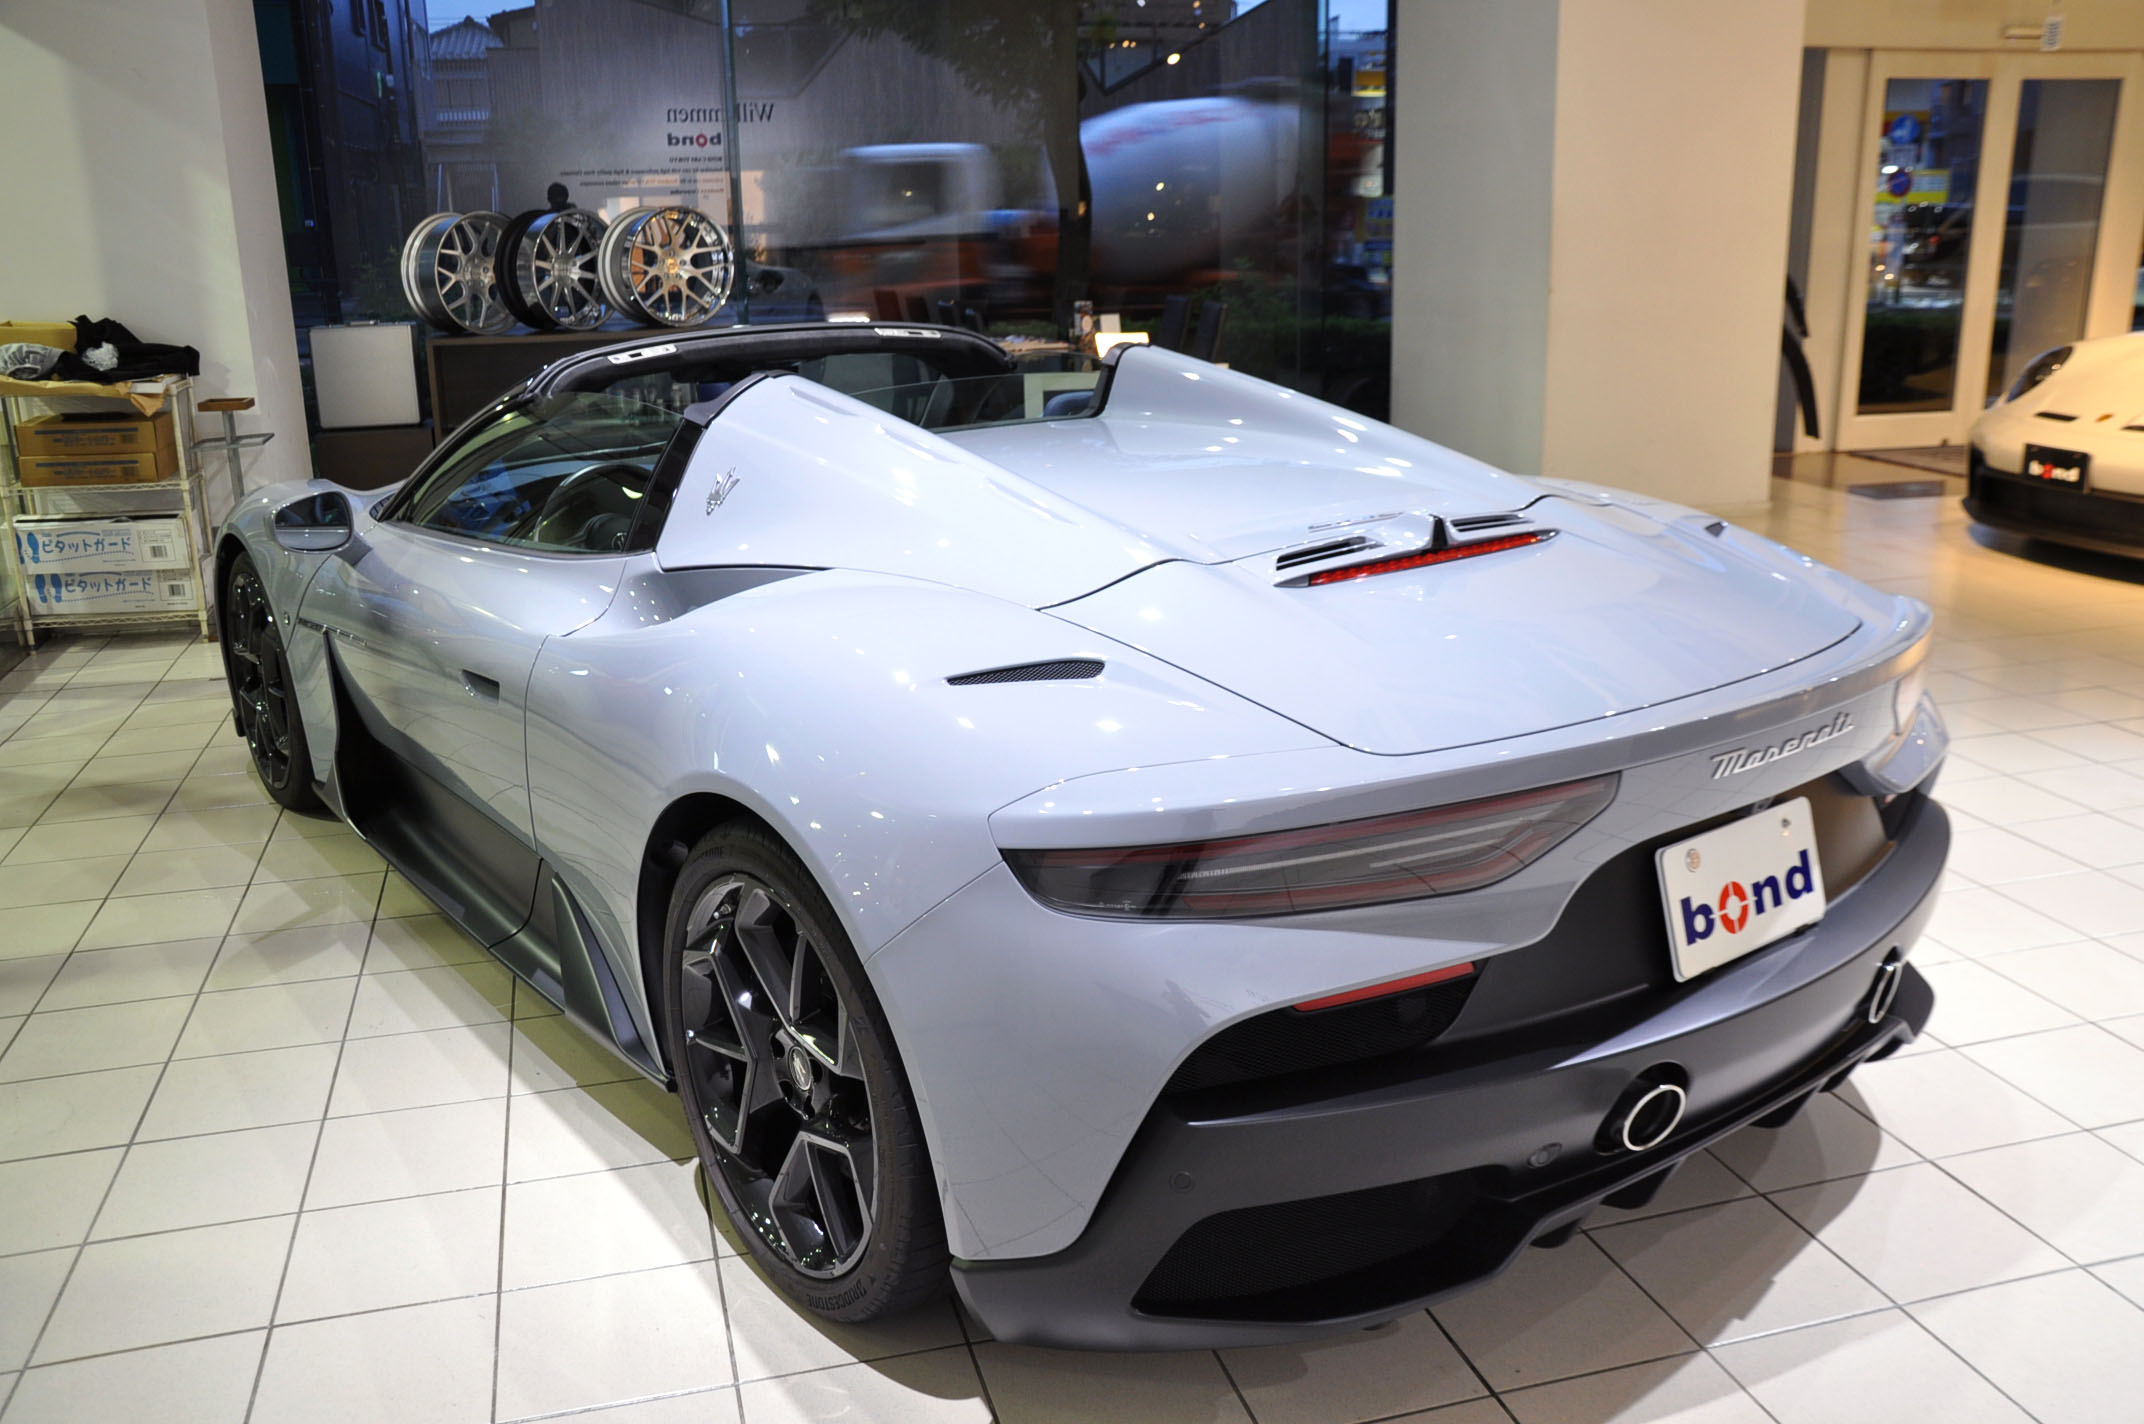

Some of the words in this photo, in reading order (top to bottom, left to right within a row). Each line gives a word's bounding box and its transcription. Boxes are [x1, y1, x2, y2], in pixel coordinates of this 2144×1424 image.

[2028, 460, 2080, 483] bond
[1710, 711, 1856, 780] Maserati
[1680, 848, 1815, 947] bond
[806, 1279, 868, 1312] BRIDGESTONE
